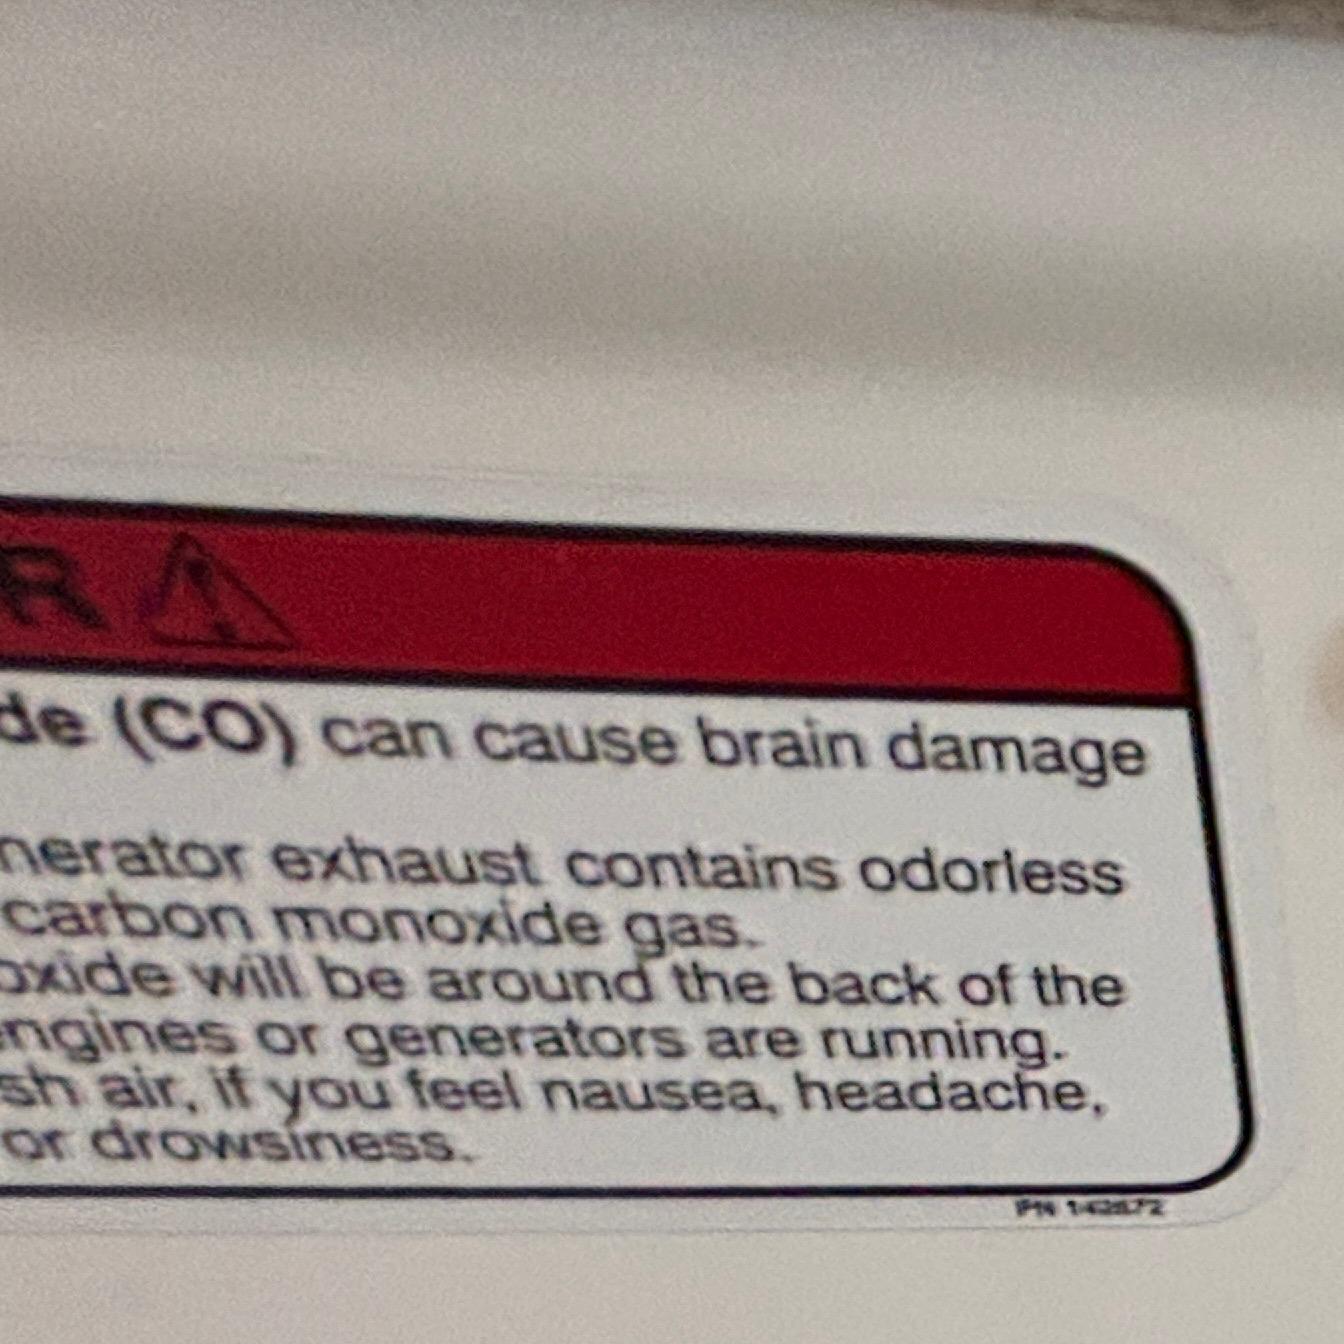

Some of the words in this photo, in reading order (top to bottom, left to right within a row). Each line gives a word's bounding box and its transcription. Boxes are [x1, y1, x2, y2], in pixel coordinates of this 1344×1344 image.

[0, 691, 88, 748] de
[113, 694, 297, 767] (CO)
[320, 713, 453, 757] can
[473, 716, 678, 766] cause
[697, 716, 868, 770] brain
[889, 722, 1147, 788] damage
[0, 832, 244, 882] nerator
[273, 835, 545, 888] exhaust
[566, 846, 840, 893] contains
[858, 848, 1127, 896] odorless
[2, 888, 254, 940] carbon
[275, 900, 602, 946] monoxide
[624, 910, 763, 957] gas.
[0, 950, 176, 997] oxide
[193, 956, 302, 1000] will
[317, 955, 405, 1000] be
[430, 962, 655, 1002] around
[672, 962, 769, 1005] the
[788, 962, 935, 1006] back
[959, 965, 1011, 1006] of
[1031, 964, 1127, 1007] the
[0, 1008, 237, 1063] ngines
[256, 1020, 318, 1056] or
[345, 1018, 687, 1067] generators
[706, 1022, 800, 1059] are
[822, 1018, 1067, 1069] running.
[0, 1065, 80, 1106] sh
[211, 1065, 251, 1109] if
[266, 1073, 388, 1127] you
[407, 1070, 514, 1111] feel
[538, 1075, 781, 1116] nausea,
[793, 1073, 1109, 1116] headache,
[2, 1129, 65, 1160] or
[91, 1119, 480, 1163] drowsiness.
